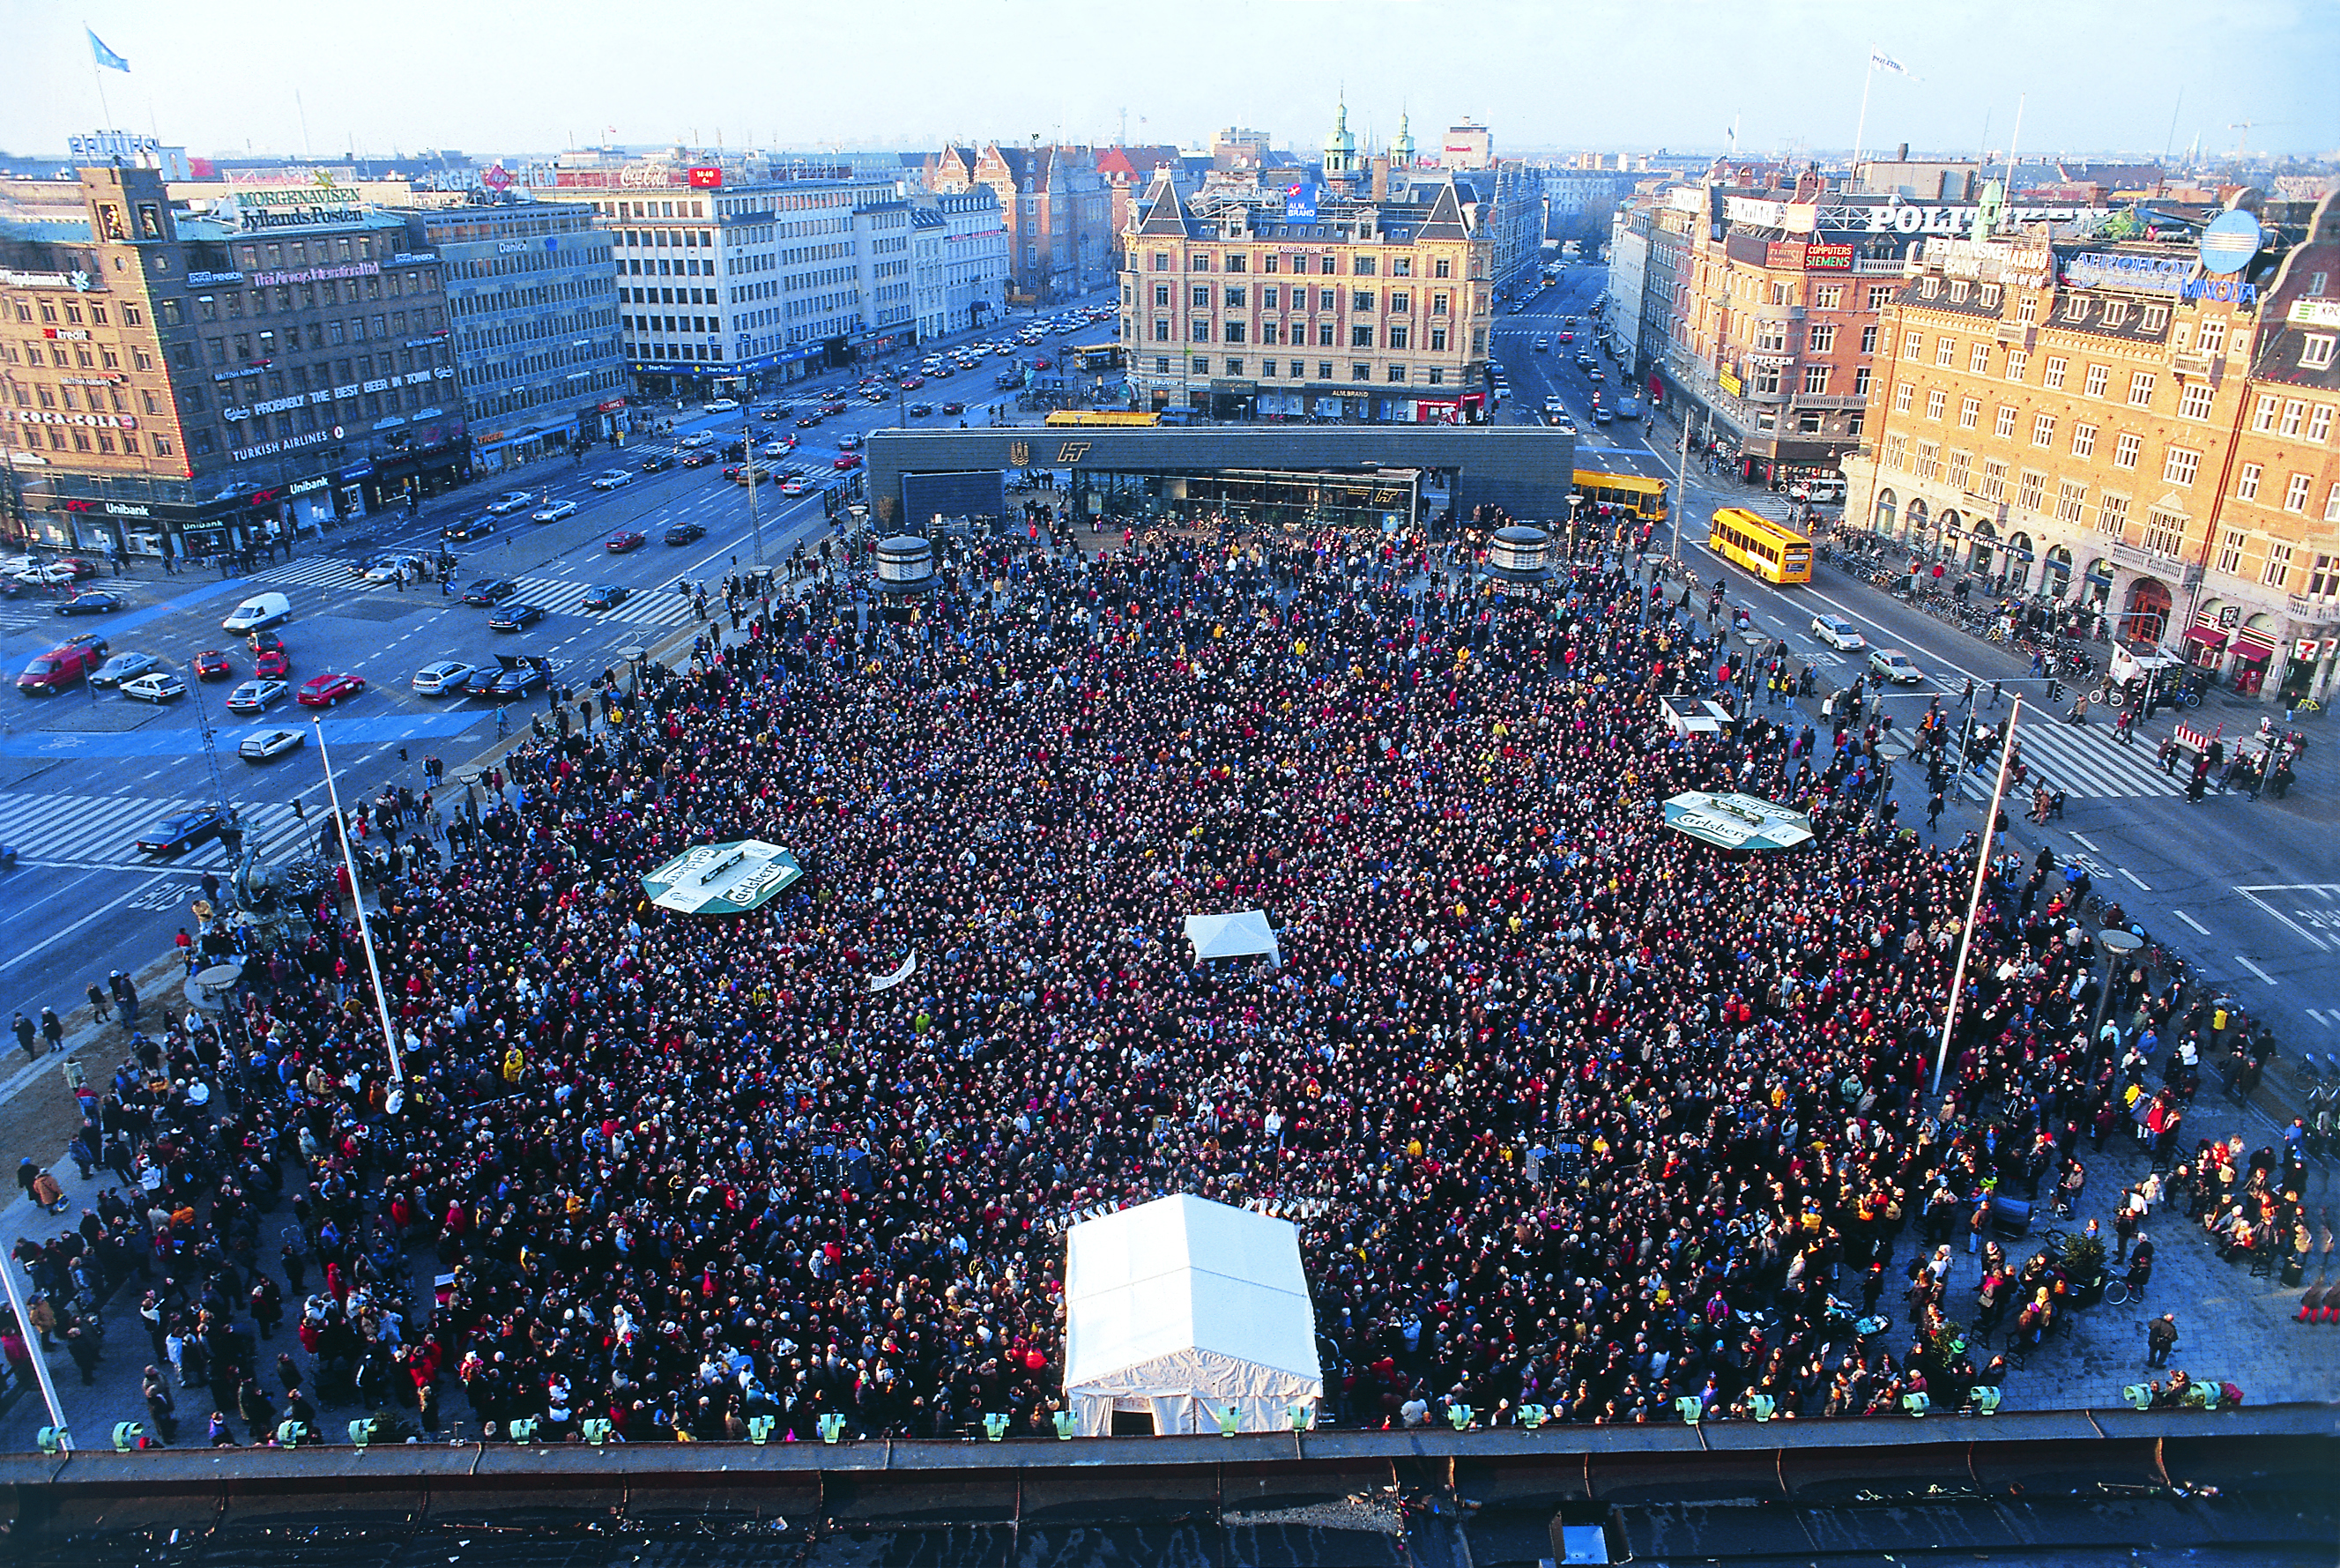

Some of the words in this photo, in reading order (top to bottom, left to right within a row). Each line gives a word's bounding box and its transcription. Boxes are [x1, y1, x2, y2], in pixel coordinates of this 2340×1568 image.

[437, 167, 484, 191] AGFA
[236, 188, 360, 207] MORGENAVISEN
[499, 242, 527, 254] Danica
[1809, 246, 1852, 256] COMPUTERS
[1926, 236, 1951, 256] DEN
[1953, 241, 2006, 259] DANSKE
[1806, 256, 1850, 268] SIEMENS
[1944, 258, 1980, 277] BANK
[2002, 249, 2047, 270] HARIBO
[2075, 252, 2195, 275] AEROFLOT
[253, 272, 275, 287] Thai
[2180, 279, 2257, 305] MINOLTA
[56, 329, 87, 340] kredit
[254, 396, 304, 415] PROBABLY
[309, 390, 330, 404] THE
[334, 384, 359, 399] BEST
[363, 379, 388, 393] BEER
[391, 376, 402, 387] IN
[405, 371, 430, 385] TOWN
[19, 411, 120, 427] COCA-COLA
[233, 444, 279, 462] TURKISH
[283, 430, 328, 450] AIRLINES
[478, 431, 504, 444] TIGER
[289, 476, 329, 494] Unibank
[106, 502, 150, 516] Unibank
[182, 519, 223, 531] Unibank
[729, 862, 788, 904] Carlsberg
